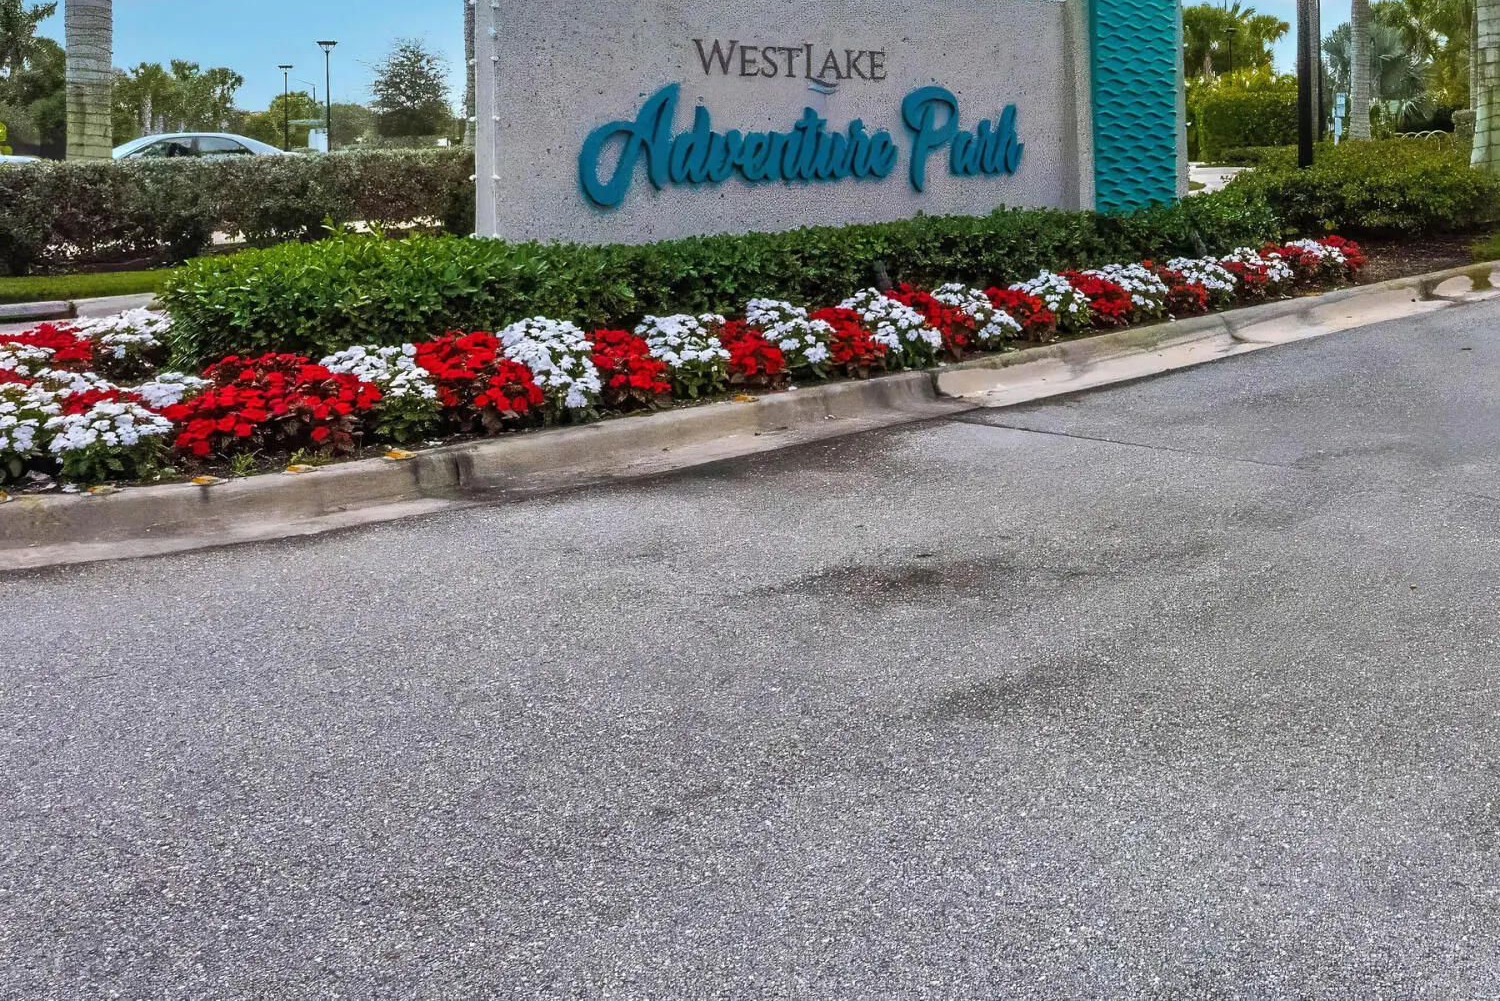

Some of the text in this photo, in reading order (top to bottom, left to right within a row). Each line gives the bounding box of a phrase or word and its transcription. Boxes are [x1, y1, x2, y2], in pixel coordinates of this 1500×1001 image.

[692, 38, 887, 87] WESTLAKE
[578, 82, 1024, 208] Adventure Park
